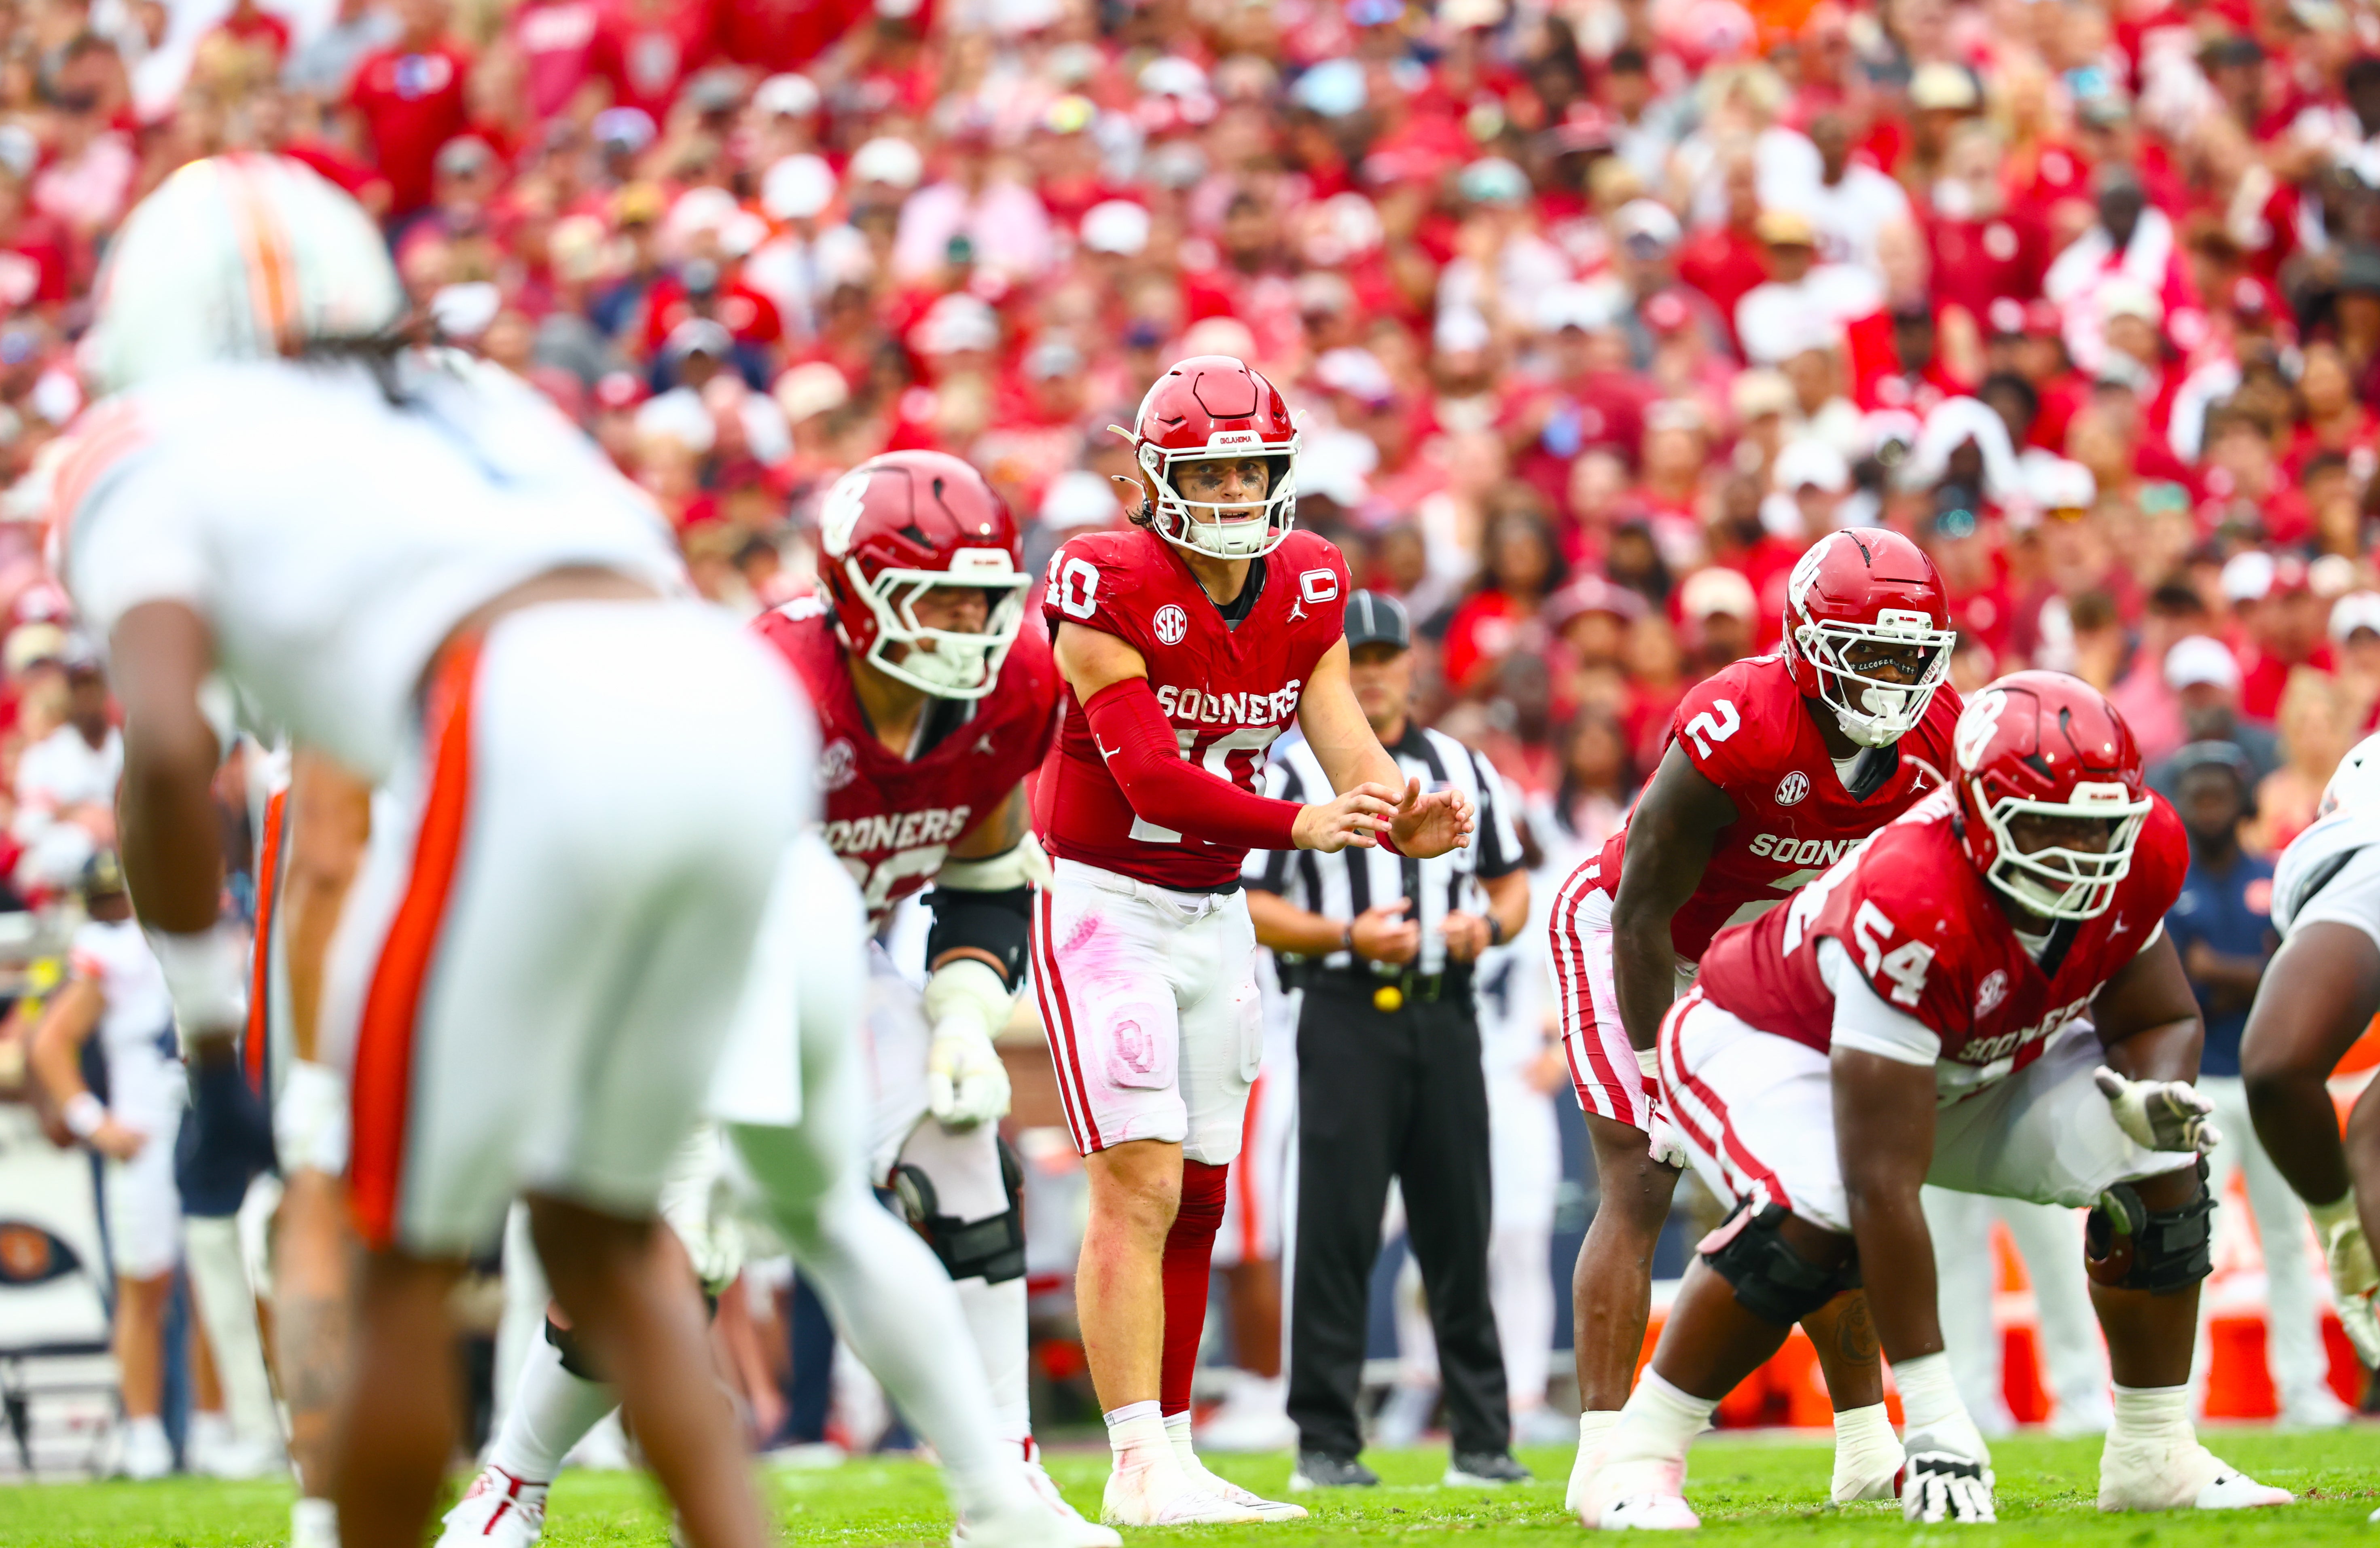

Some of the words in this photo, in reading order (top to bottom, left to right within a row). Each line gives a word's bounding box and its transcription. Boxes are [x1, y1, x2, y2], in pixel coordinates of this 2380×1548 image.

[1220, 436, 1252, 444] OKLAHOMA
[1045, 550, 1100, 620] 10
[1302, 570, 1336, 601] C
[1156, 607, 1184, 643] SEC
[1919, 660, 1939, 685] SPORT
[1156, 679, 1301, 725] SOONERS
[1684, 699, 1741, 760] 2
[1777, 774, 1808, 804] SEC
[811, 805, 972, 852] OONERS
[1853, 899, 1935, 1008] 54
